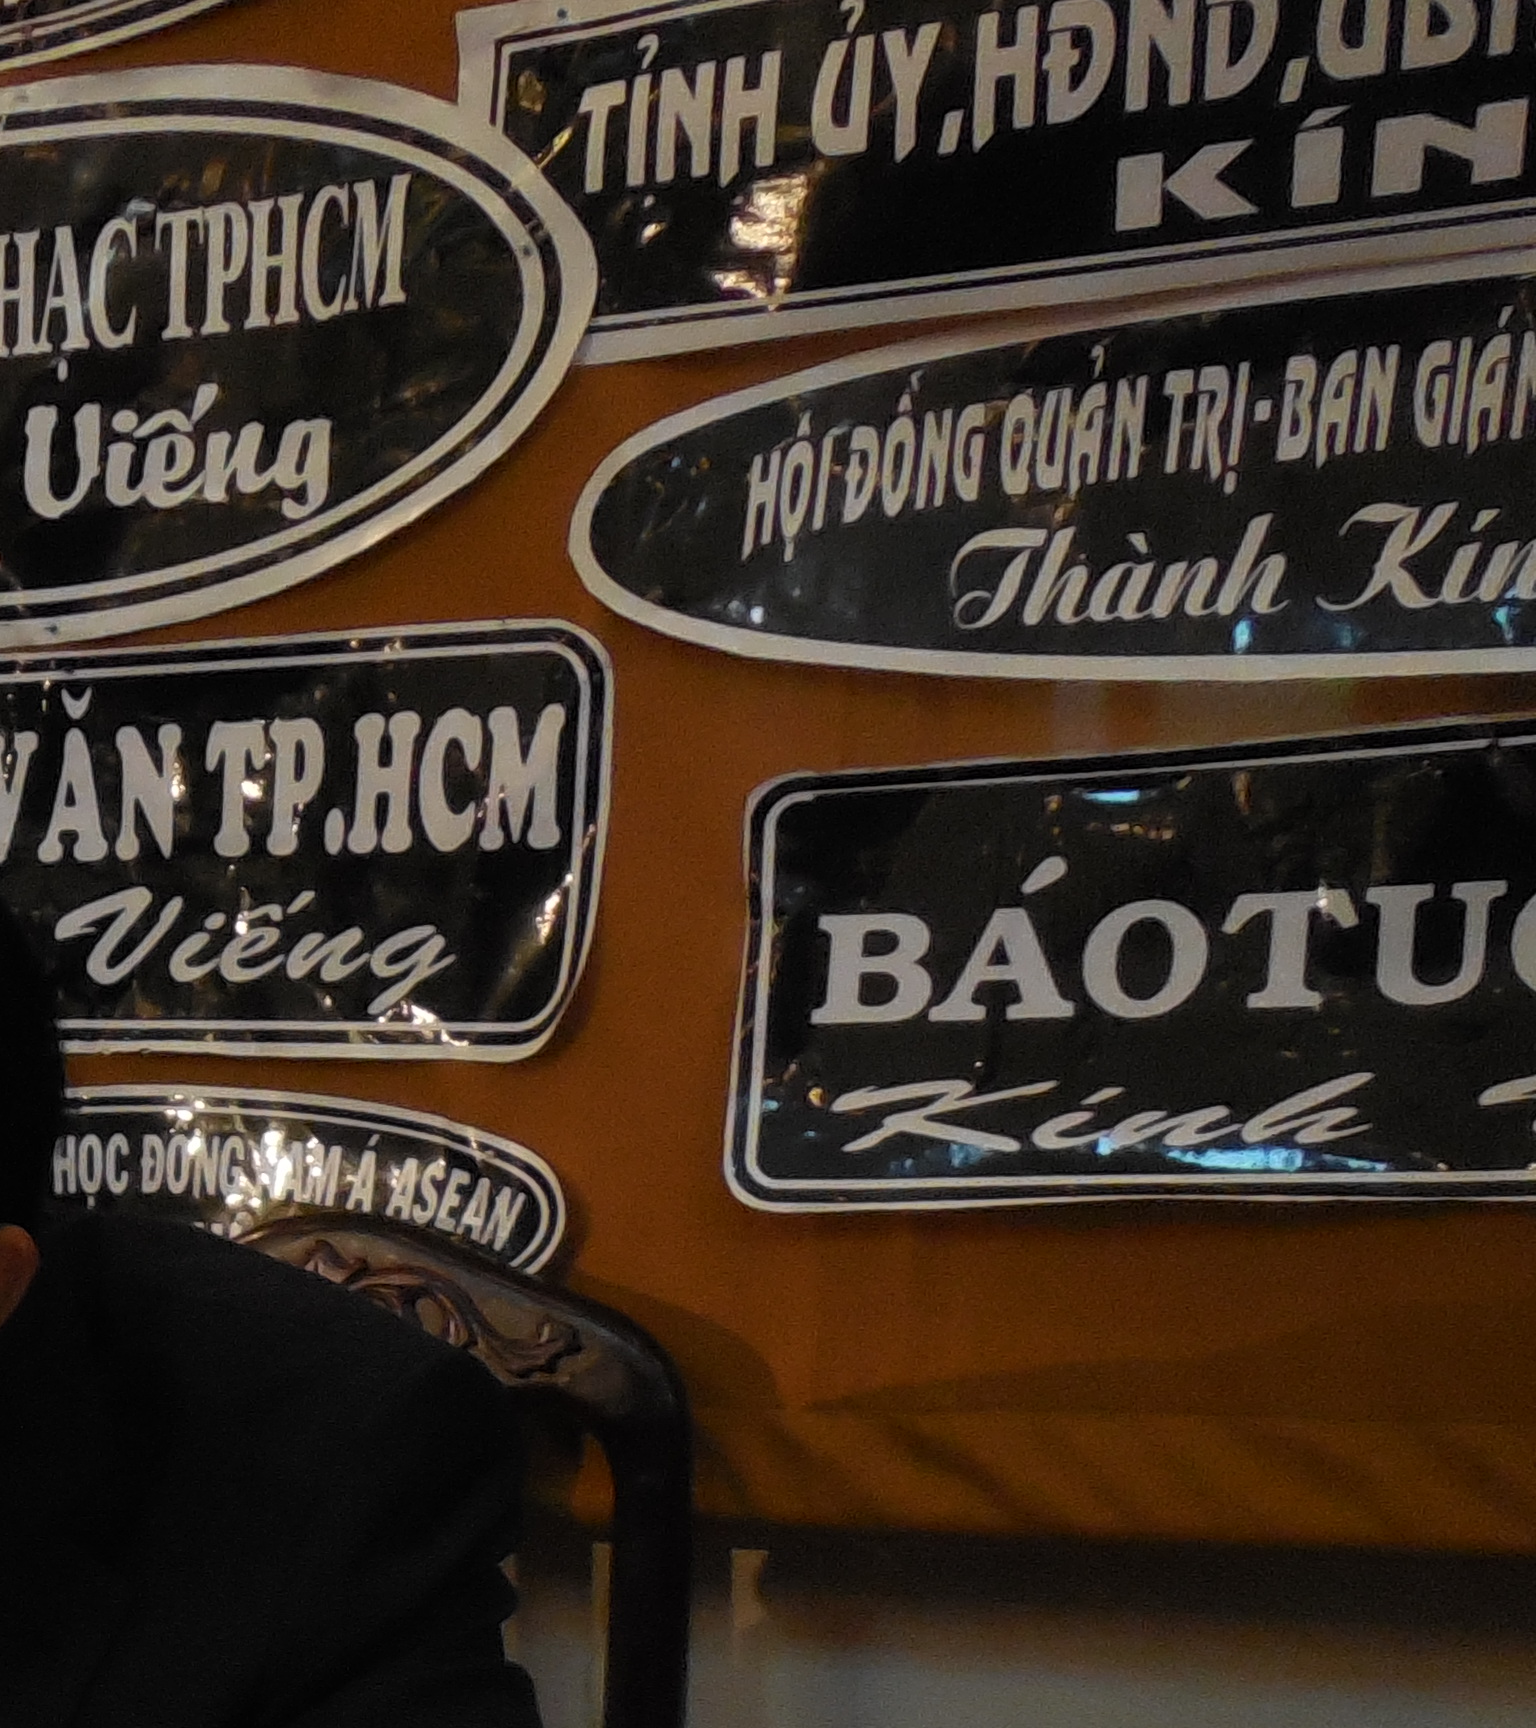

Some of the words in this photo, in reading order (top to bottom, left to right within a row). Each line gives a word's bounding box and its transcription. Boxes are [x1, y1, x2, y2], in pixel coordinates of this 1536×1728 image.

[579, 34, 781, 193] TỈNH
[1114, 98, 1528, 232] KÍN
[155, 174, 412, 341] TPHCM
[741, 411, 837, 563] HỘI
[1000, 344, 1148, 498] QUẢN
[949, 513, 1289, 629] Thành
[205, 703, 566, 858] TP.HCM
[54, 885, 457, 1014] Viếng
[832, 1072, 1375, 1152] Kính
[53, 1134, 129, 1209] HỌC
[347, 1135, 379, 1212] Á
[386, 1157, 525, 1252] ASEAN
